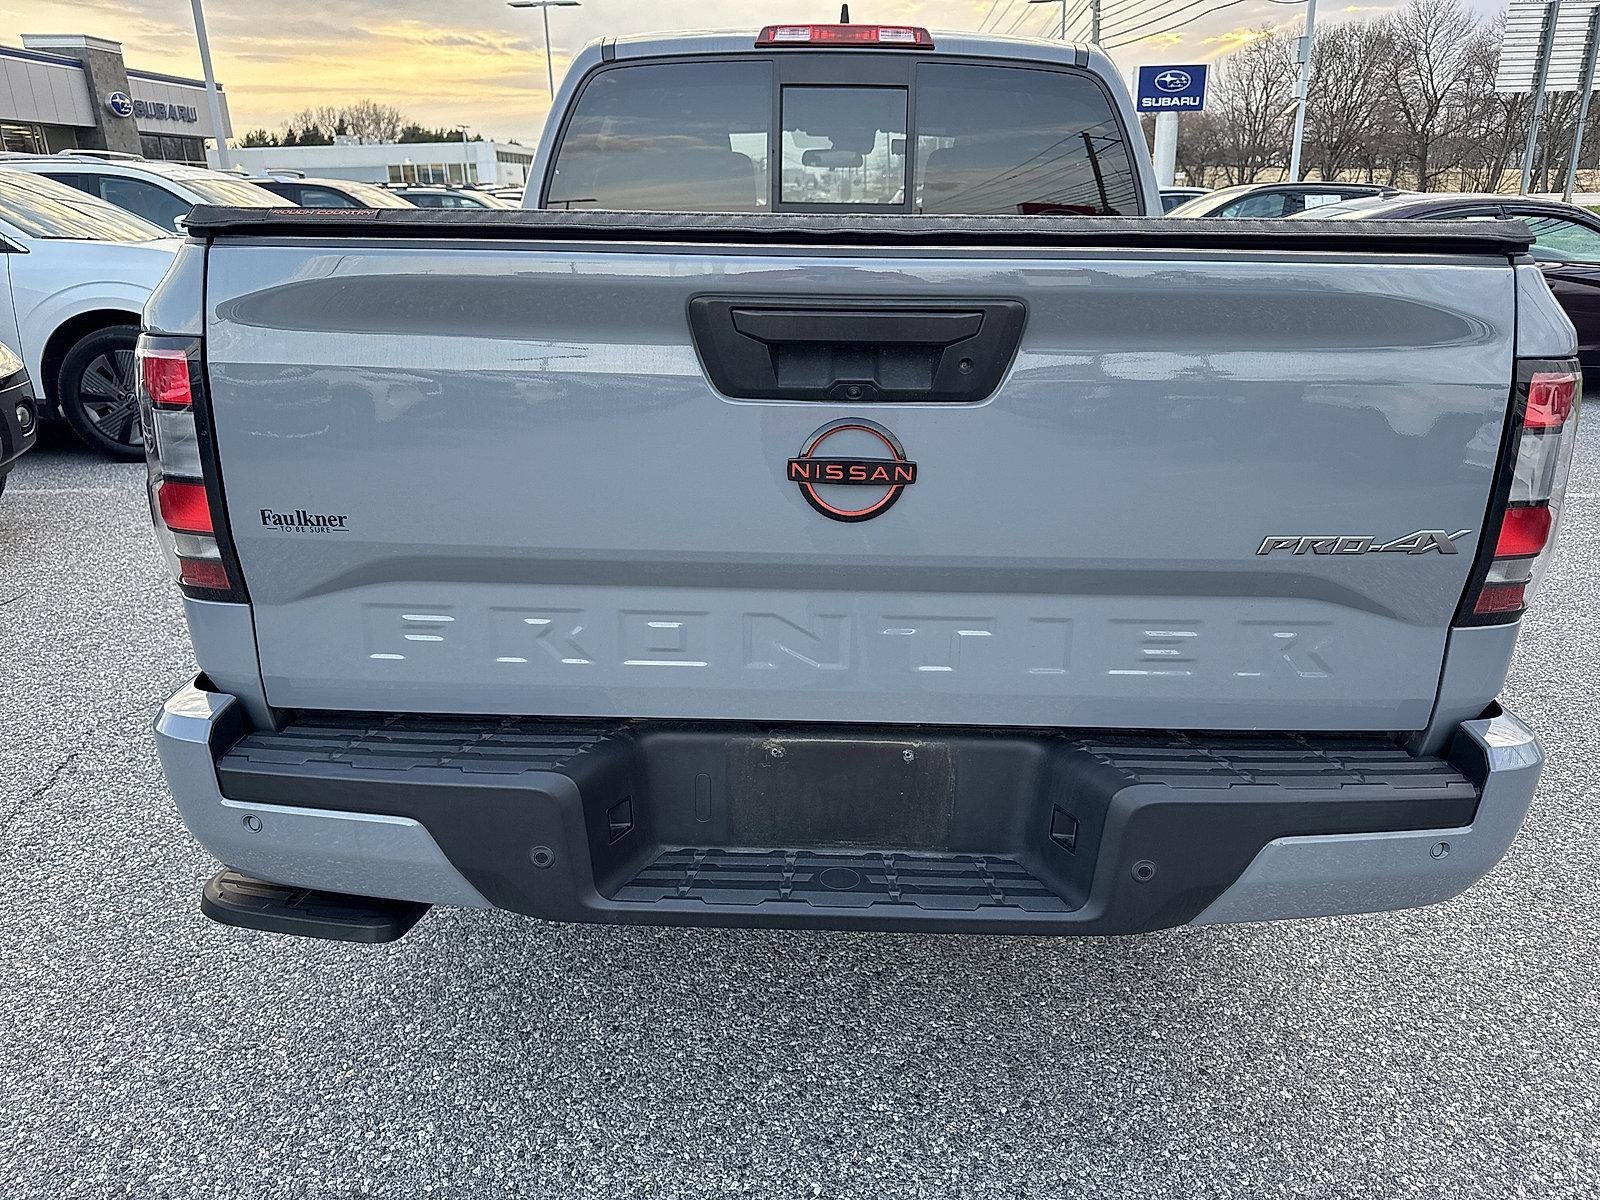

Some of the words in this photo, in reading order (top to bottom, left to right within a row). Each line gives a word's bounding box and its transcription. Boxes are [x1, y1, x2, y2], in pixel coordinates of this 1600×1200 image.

[1141, 96, 1200, 107] SUBARU
[133, 100, 197, 123] SUBARU
[791, 462, 913, 481] NISSAN
[260, 509, 347, 527] Faulkner
[309, 526, 331, 534] SURE
[1256, 529, 1473, 555] PRO-4X
[361, 602, 1334, 679] FRONTIER
